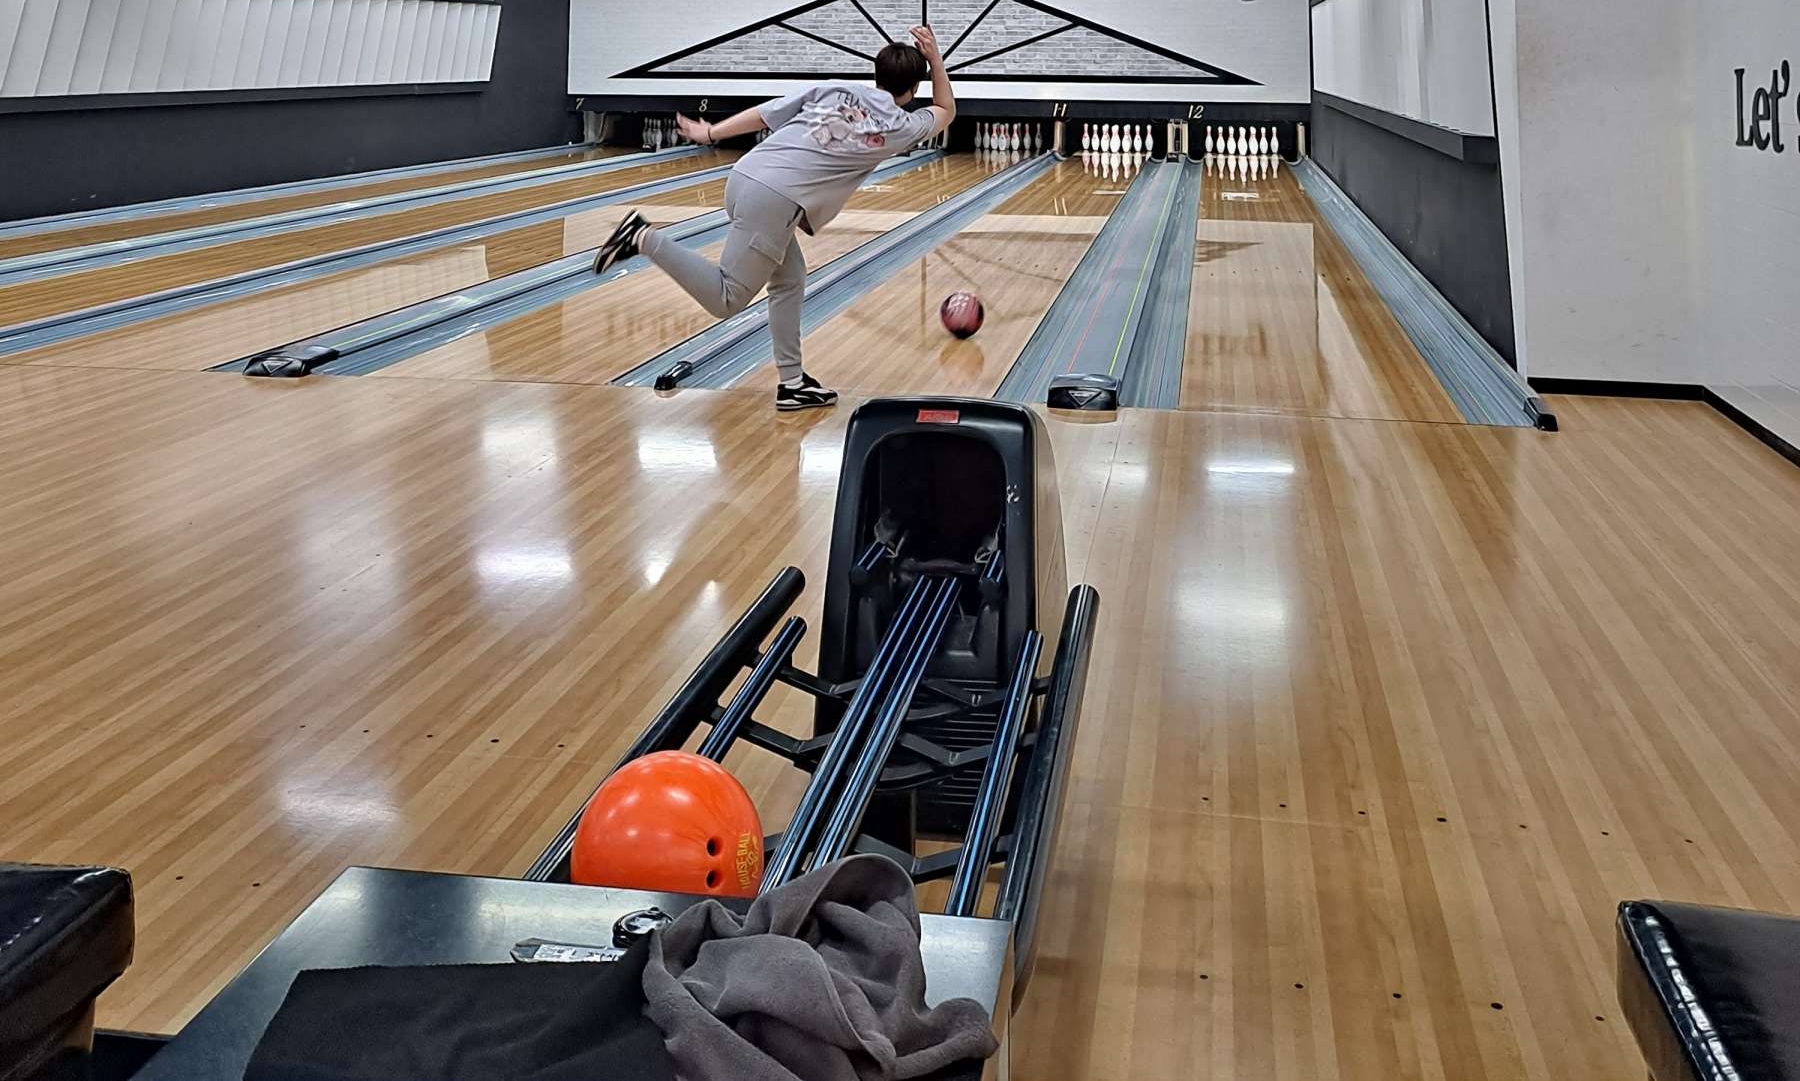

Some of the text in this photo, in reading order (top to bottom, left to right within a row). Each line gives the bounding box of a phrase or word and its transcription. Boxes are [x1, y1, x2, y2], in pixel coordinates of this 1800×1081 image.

[699, 98, 709, 113] 8
[1187, 103, 1205, 120] 12
[1733, 59, 1800, 154] Let'
